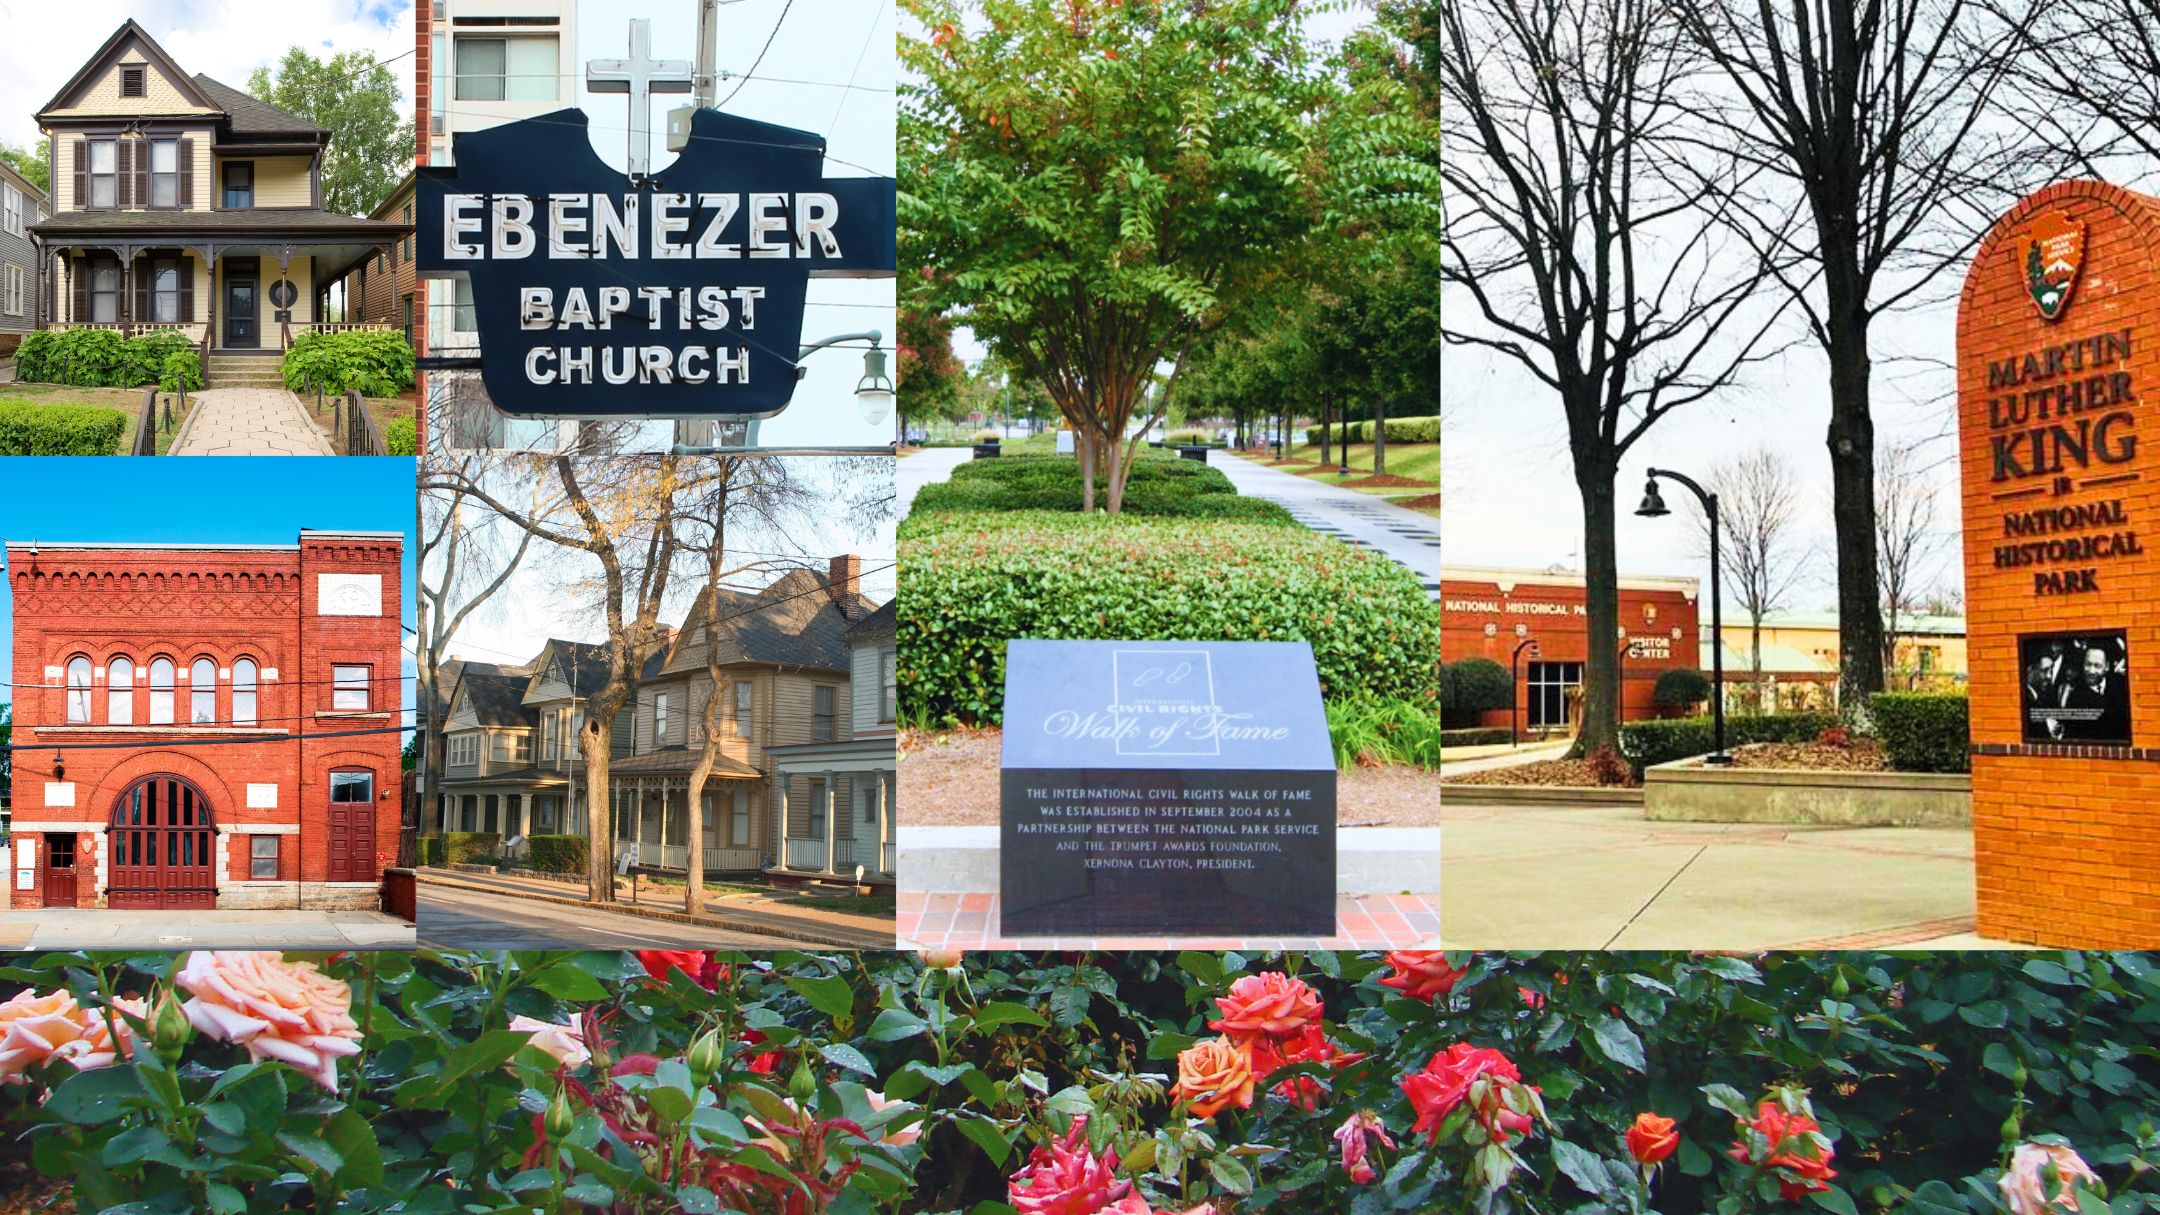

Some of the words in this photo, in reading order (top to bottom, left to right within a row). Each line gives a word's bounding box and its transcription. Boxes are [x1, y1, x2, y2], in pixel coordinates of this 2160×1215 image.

[443, 192, 843, 260] EBENEZER
[520, 286, 765, 331] BAPTIST
[525, 345, 750, 385] CHURCH
[1988, 327, 2132, 392] MARTIN
[1989, 371, 2138, 429] LUTHER
[1991, 410, 2138, 482] KING
[2003, 499, 2128, 537] NATIONAL
[1993, 531, 2144, 568] HISTORICAL
[2034, 568, 2099, 597] PARK
[1445, 600, 1500, 613] NATIONAL
[1505, 602, 1568, 616] HISTORICAL
[1573, 605, 1587, 616] PA
[1107, 704, 1154, 713] CIVIL
[1158, 704, 1224, 714] RIGHTS
[1043, 710, 1140, 741] Walk
[1149, 716, 1188, 748] of
[1185, 713, 1289, 741] Fame
[1026, 788, 1048, 799] THE
[1053, 788, 1144, 799] INTERNATIONAL
[1148, 788, 1179, 799] CIVIL
[1183, 789, 1224, 800] RIGHTS
[1229, 790, 1259, 800] WALK
[1263, 790, 1279, 800] OF
[1283, 790, 1312, 800] FAME
[1040, 806, 1062, 817] WAS
[1066, 806, 1140, 817] ESTABLISHED
[1144, 806, 1157, 817] IN
[1161, 806, 1225, 817] SEPTEMBER
[1229, 807, 1261, 817] 2004
[1266, 807, 1280, 817] AS
[1284, 808, 1292, 817] A
[1017, 823, 1092, 833] PARTNERSHIP
[1096, 823, 1149, 834] BETWEEN
[1154, 824, 1175, 834] THE
[1180, 824, 1236, 834] NATIONAL
[1241, 825, 1270, 834] PARK
[1274, 825, 1320, 835] SERVICE
[1056, 841, 1079, 851] AND
[1085, 841, 1105, 851] THE
[1110, 841, 1158, 851] TRUMPET
[1163, 842, 1206, 851] AWARDS
[1083, 858, 1134, 869] XERNONA
[1196, 859, 1255, 869] PRESIDENT.
